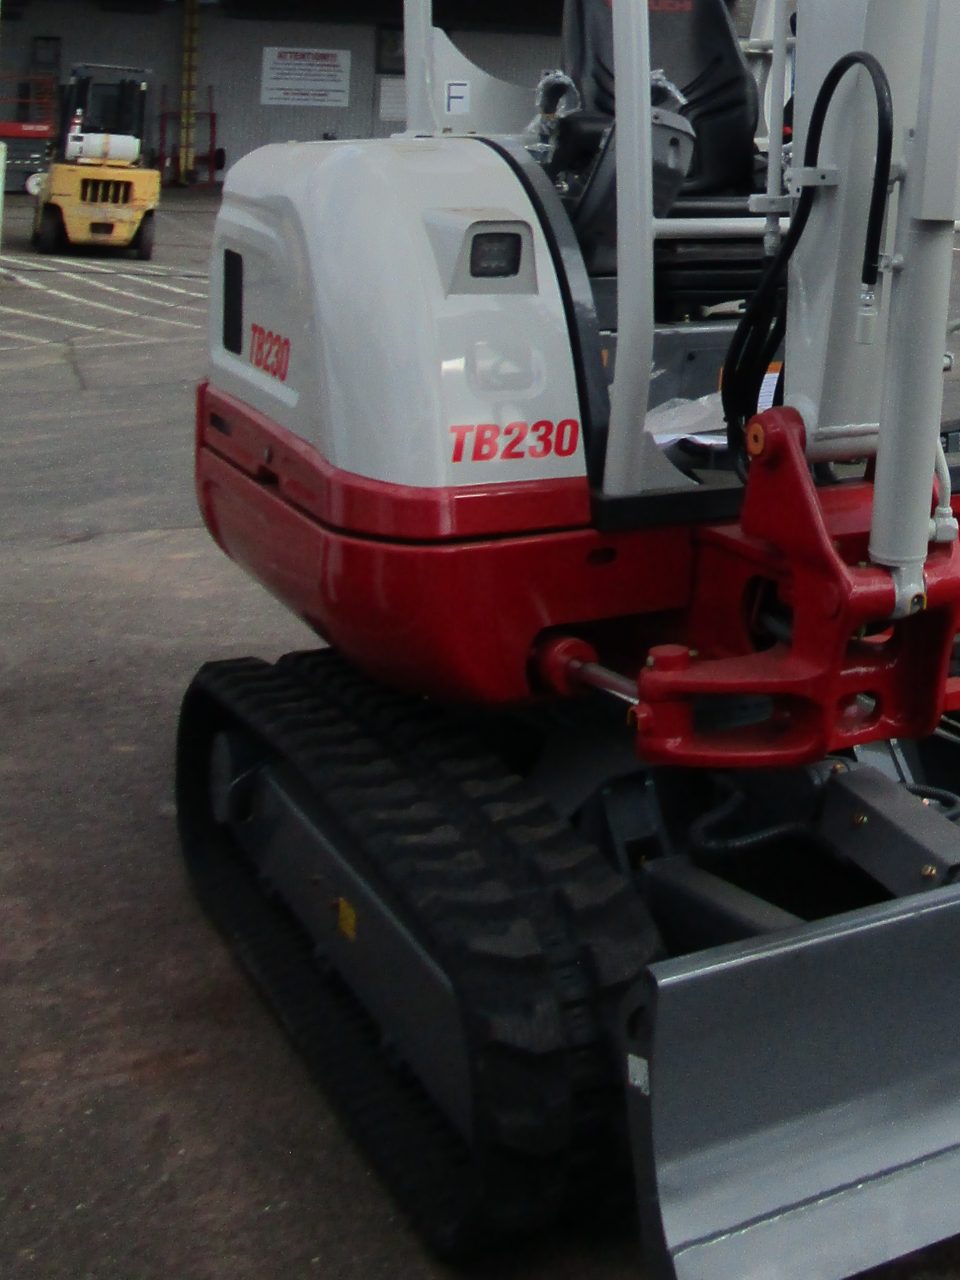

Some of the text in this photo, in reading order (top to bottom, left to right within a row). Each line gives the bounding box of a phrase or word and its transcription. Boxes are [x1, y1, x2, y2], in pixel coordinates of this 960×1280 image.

[447, 82, 468, 113] F
[251, 323, 290, 381] TB230
[450, 418, 579, 462] TB230
